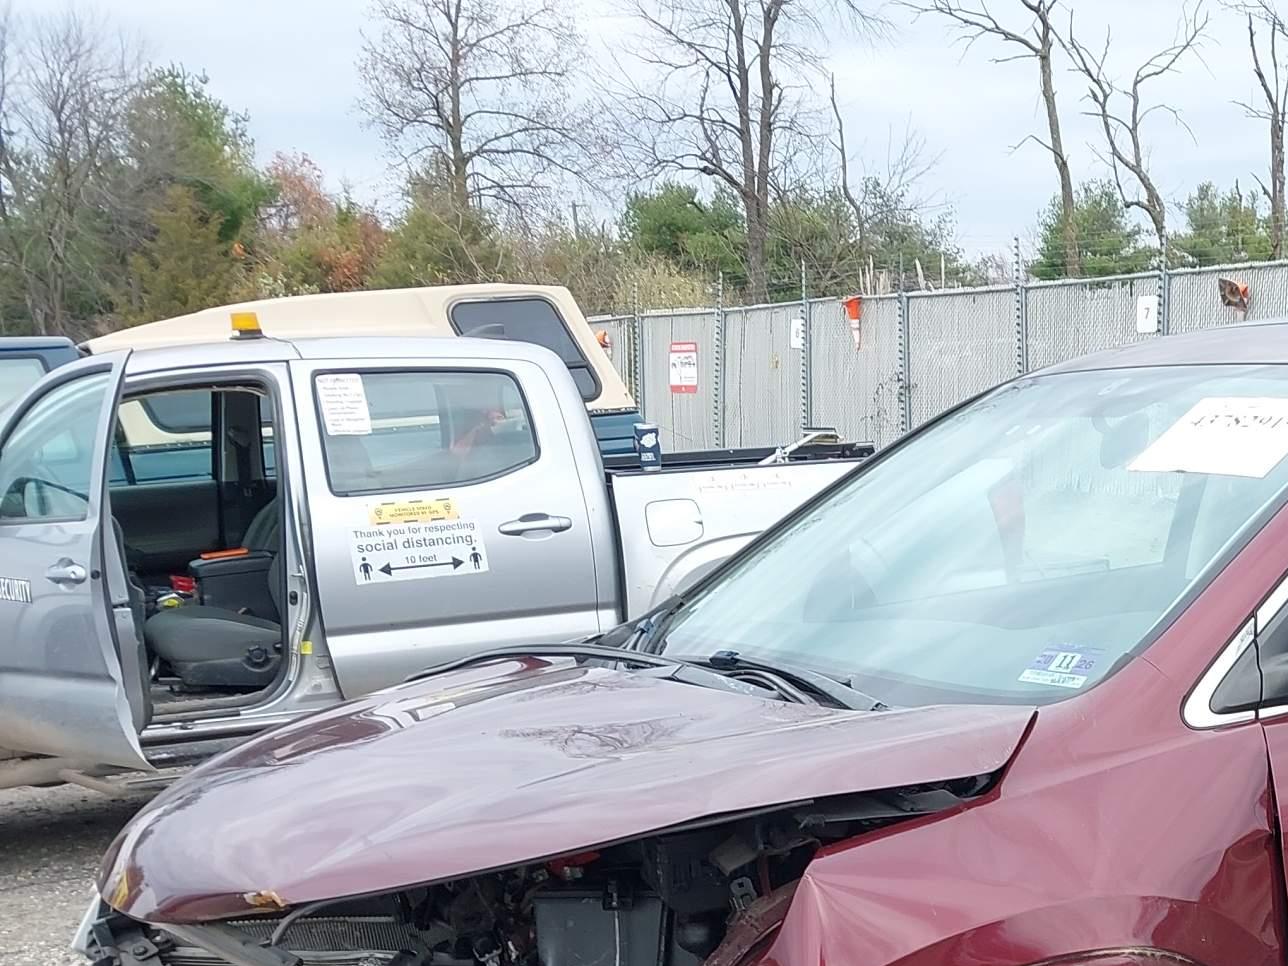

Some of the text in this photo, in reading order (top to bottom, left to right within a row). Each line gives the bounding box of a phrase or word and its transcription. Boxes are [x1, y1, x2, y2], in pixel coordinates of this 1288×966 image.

[1144, 307, 1151, 320] 7
[353, 521, 475, 539] Thank you for respecting
[357, 534, 477, 553] social distancing.
[405, 553, 438, 564] 10 feet
[1055, 655, 1075, 669] 11
[1074, 660, 1094, 670] 26
